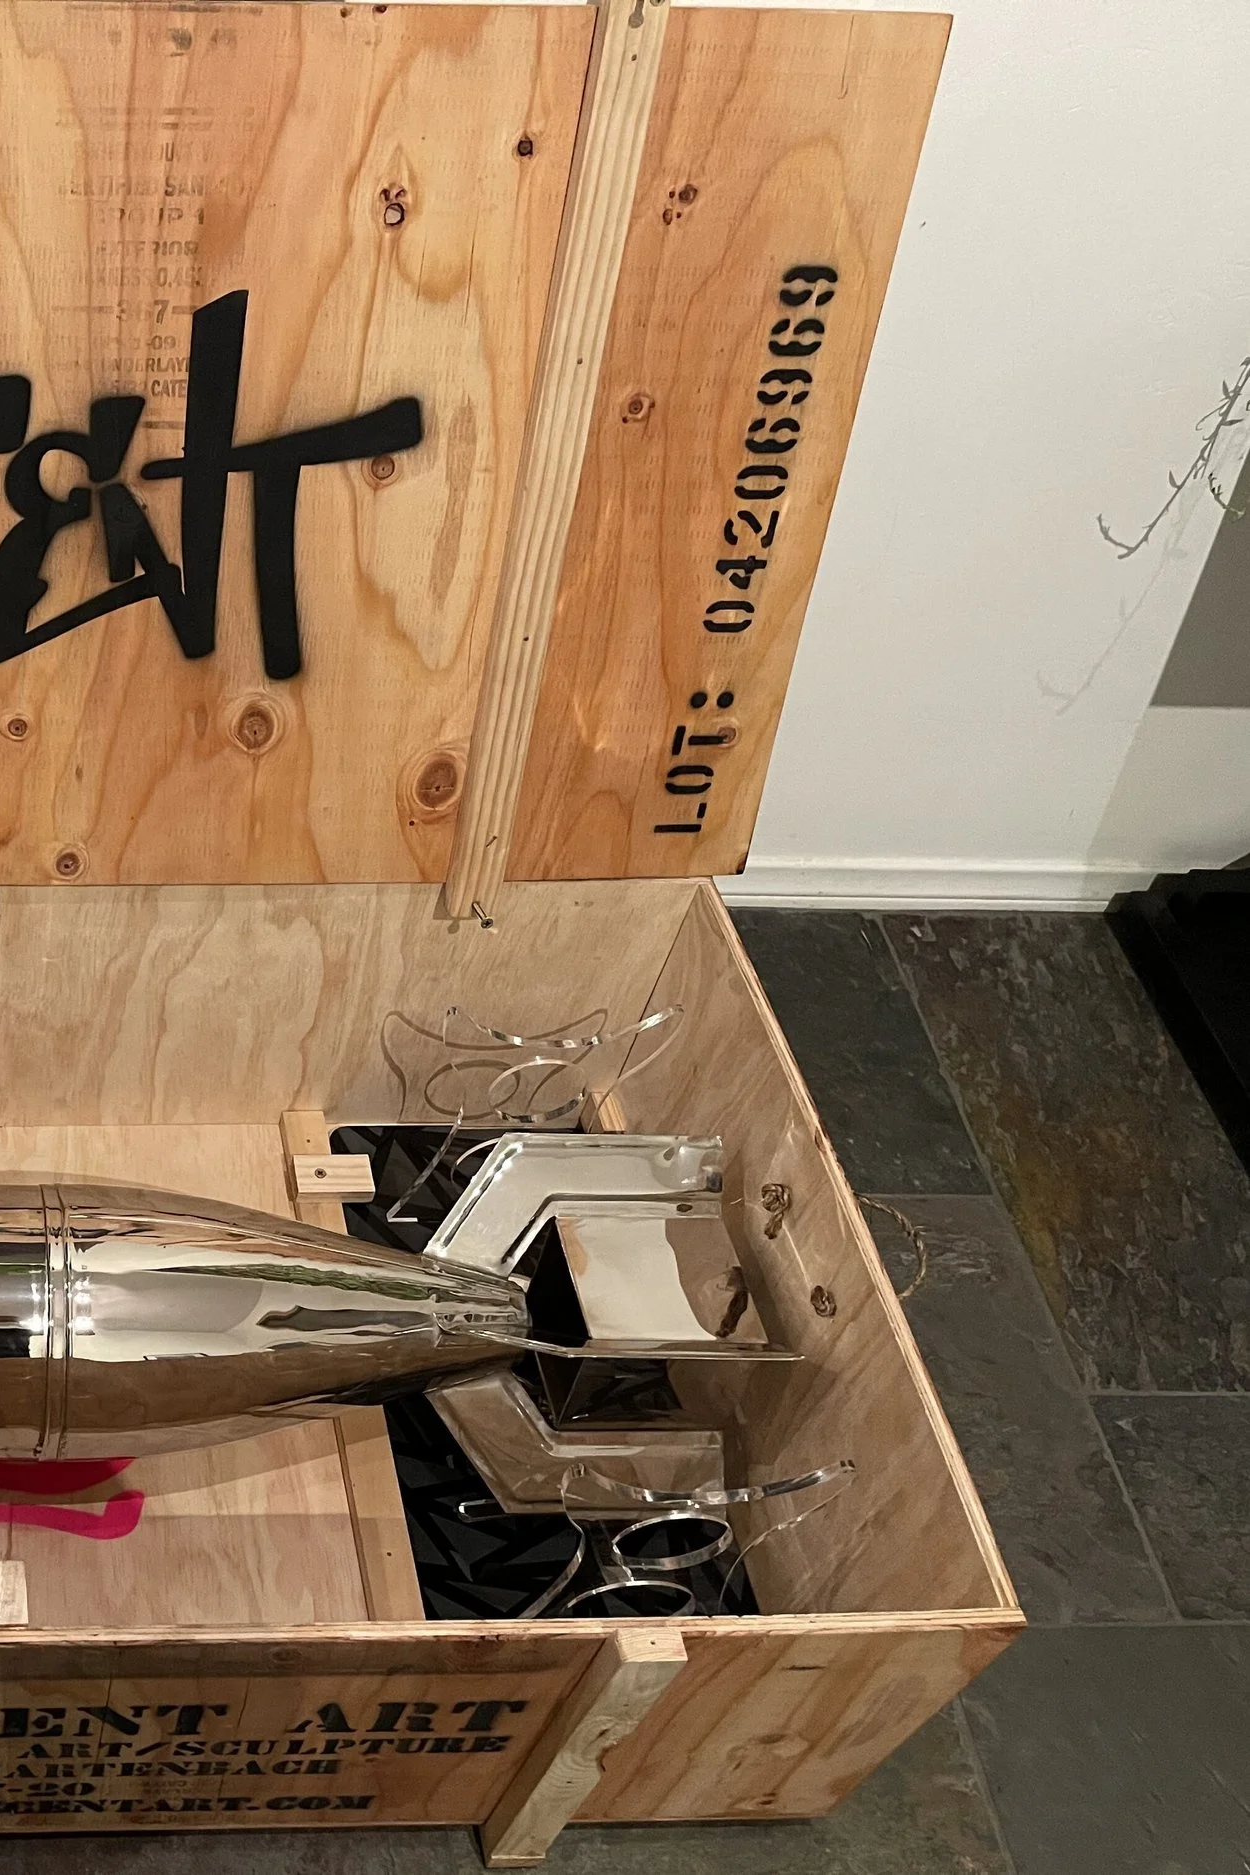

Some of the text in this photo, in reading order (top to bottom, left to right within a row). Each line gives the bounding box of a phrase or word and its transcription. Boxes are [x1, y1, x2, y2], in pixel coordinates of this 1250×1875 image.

[703, 264, 839, 634] 04206969
[285, 1699, 530, 1734] ART
[17, 1736, 514, 1760] ART/SCULPTURE
